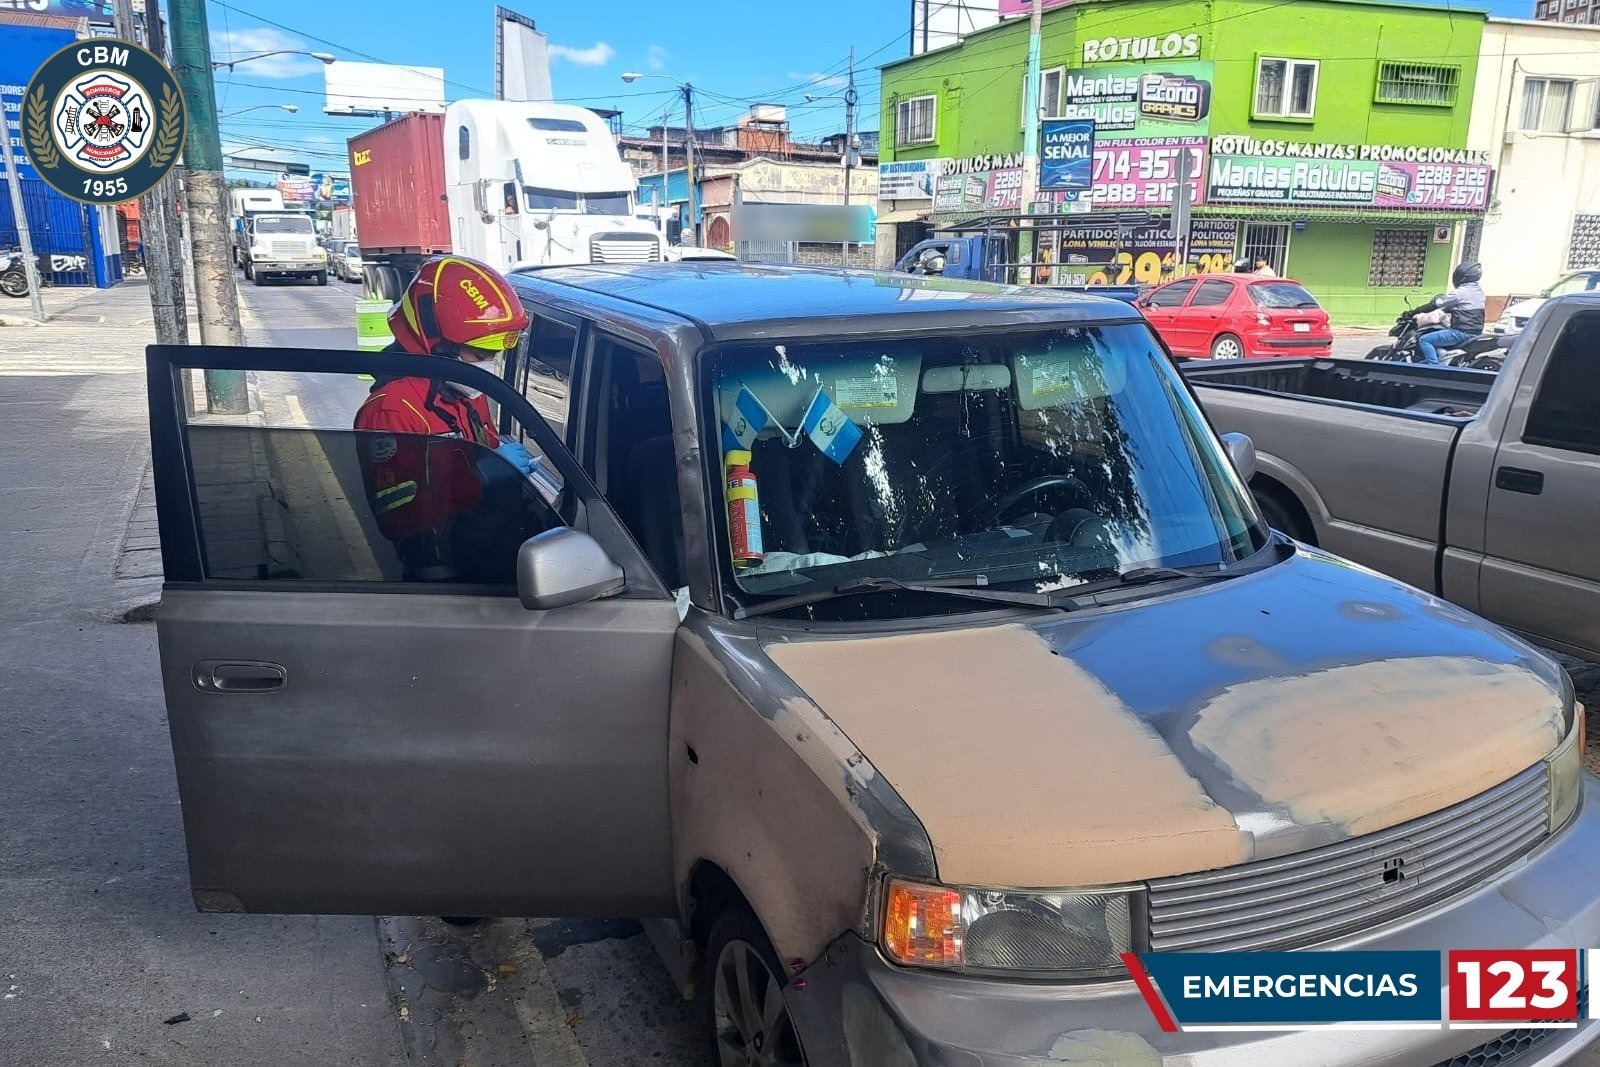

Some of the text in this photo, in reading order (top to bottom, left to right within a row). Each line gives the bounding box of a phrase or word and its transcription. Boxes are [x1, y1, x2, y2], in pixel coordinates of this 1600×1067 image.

[1083, 33, 1199, 62] ROTULOS
[1067, 74, 1138, 97] Mantas
[1142, 75, 1198, 103] Econo
[1141, 102, 1197, 117] GRAPHICS
[1046, 132, 1090, 143] LA MEJOR
[1112, 139, 1134, 147] FULL
[1136, 138, 1164, 146] COLOR
[1180, 137, 1203, 145] TELA
[1044, 143, 1091, 159] SEÑAL
[1212, 137, 1490, 163] ROTULOS MANTAS PROMOCIONALES
[942, 152, 1023, 176] ROTULOS MAN
[1094, 149, 1203, 180] 714-350
[994, 171, 1022, 189] 2288
[1212, 159, 1374, 191] Mantas Rótulos
[1416, 165, 1487, 186] 2288-2126
[1415, 184, 1485, 205] 5714-3570
[1063, 230, 1118, 239] PARTIDOS
[1192, 221, 1235, 230] PARTIDOS
[1192, 230, 1236, 240] POLÍTICOS
[1063, 240, 1086, 248] LONA
[459, 279, 490, 310] CBM
